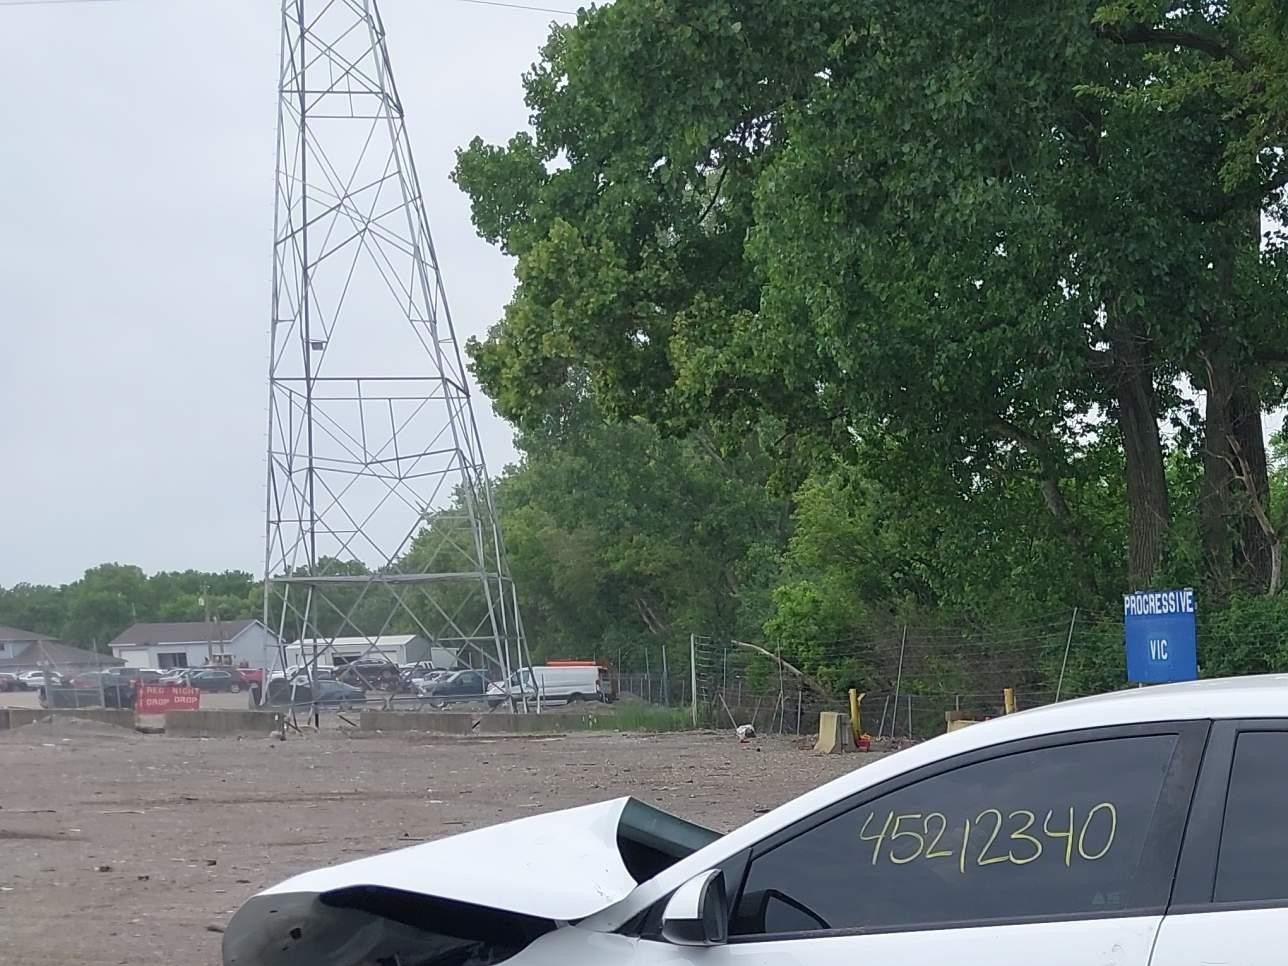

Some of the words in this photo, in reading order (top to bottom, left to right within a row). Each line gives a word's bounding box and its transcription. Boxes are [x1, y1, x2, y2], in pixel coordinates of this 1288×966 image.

[1124, 591, 1194, 616] PROGRESSIVE
[1150, 639, 1168, 660] VIC
[860, 803, 1117, 873] 45212340
